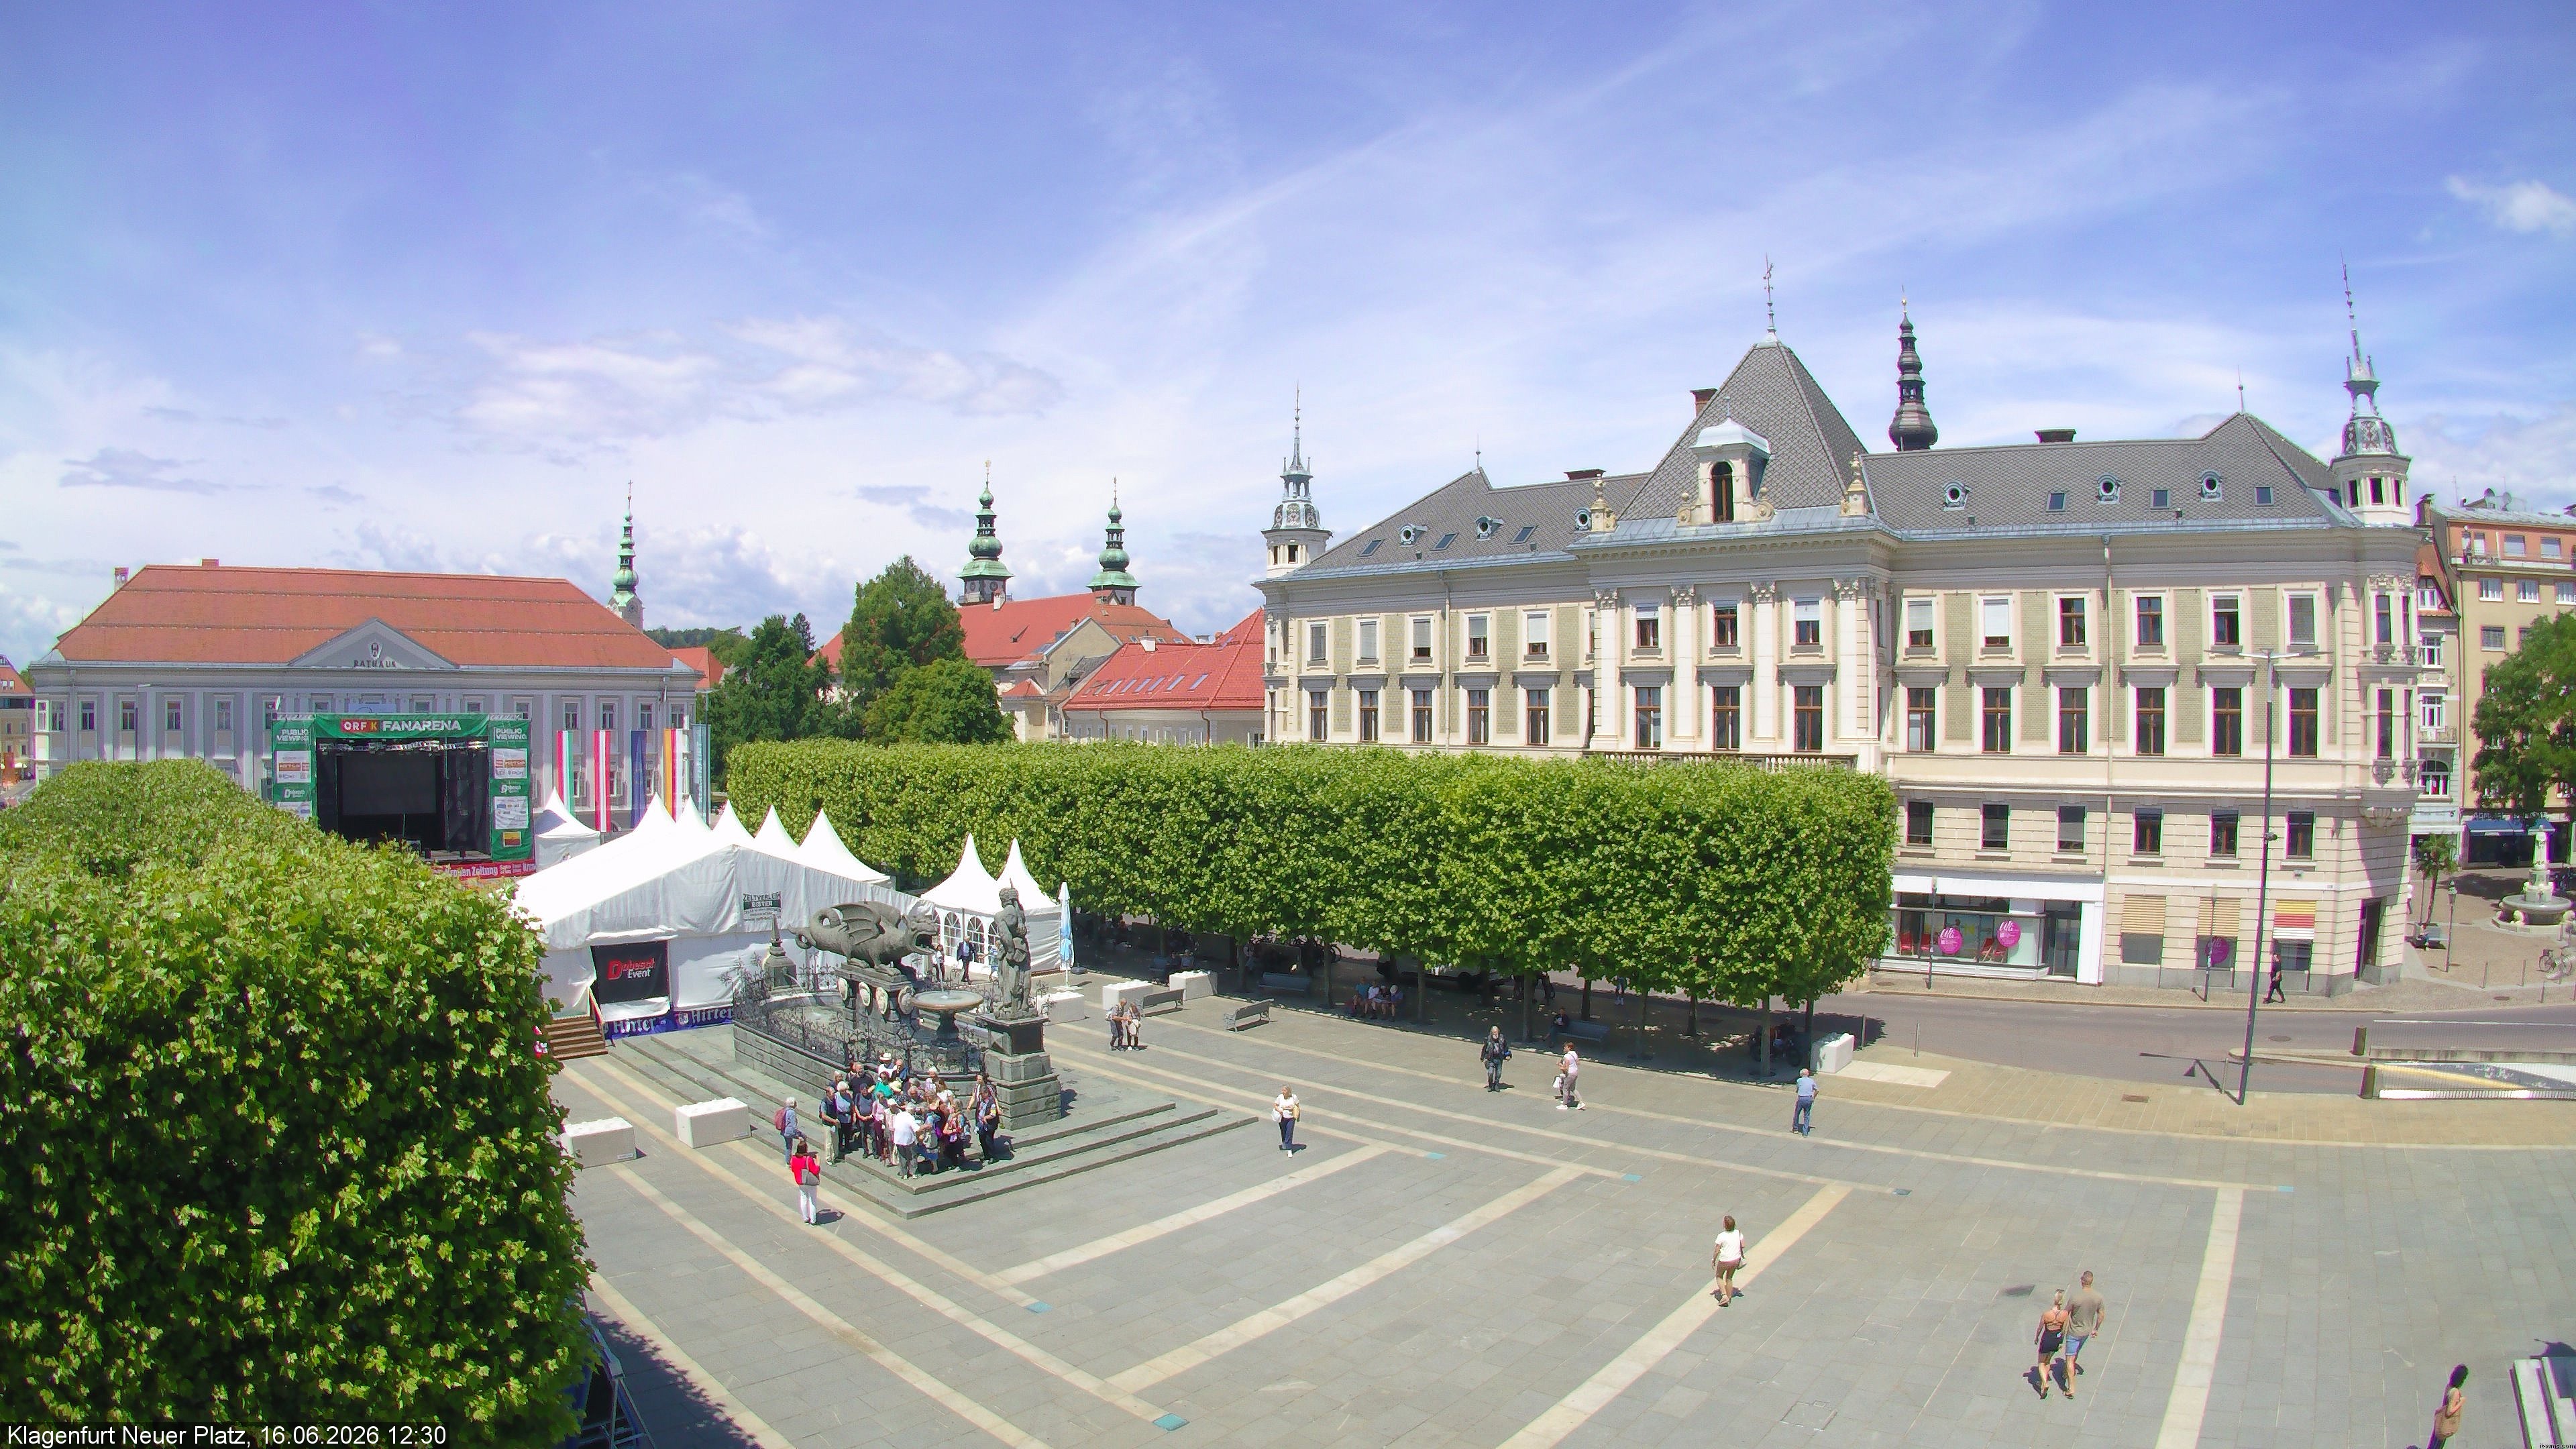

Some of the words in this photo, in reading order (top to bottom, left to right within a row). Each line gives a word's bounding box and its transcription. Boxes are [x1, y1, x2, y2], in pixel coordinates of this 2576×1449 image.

[354, 659, 396, 668] RATHAUS
[343, 720, 367, 731] ORF
[382, 720, 462, 731] FANARENA
[743, 892, 782, 902] ZELTVERLEIH
[628, 968, 651, 979] Event
